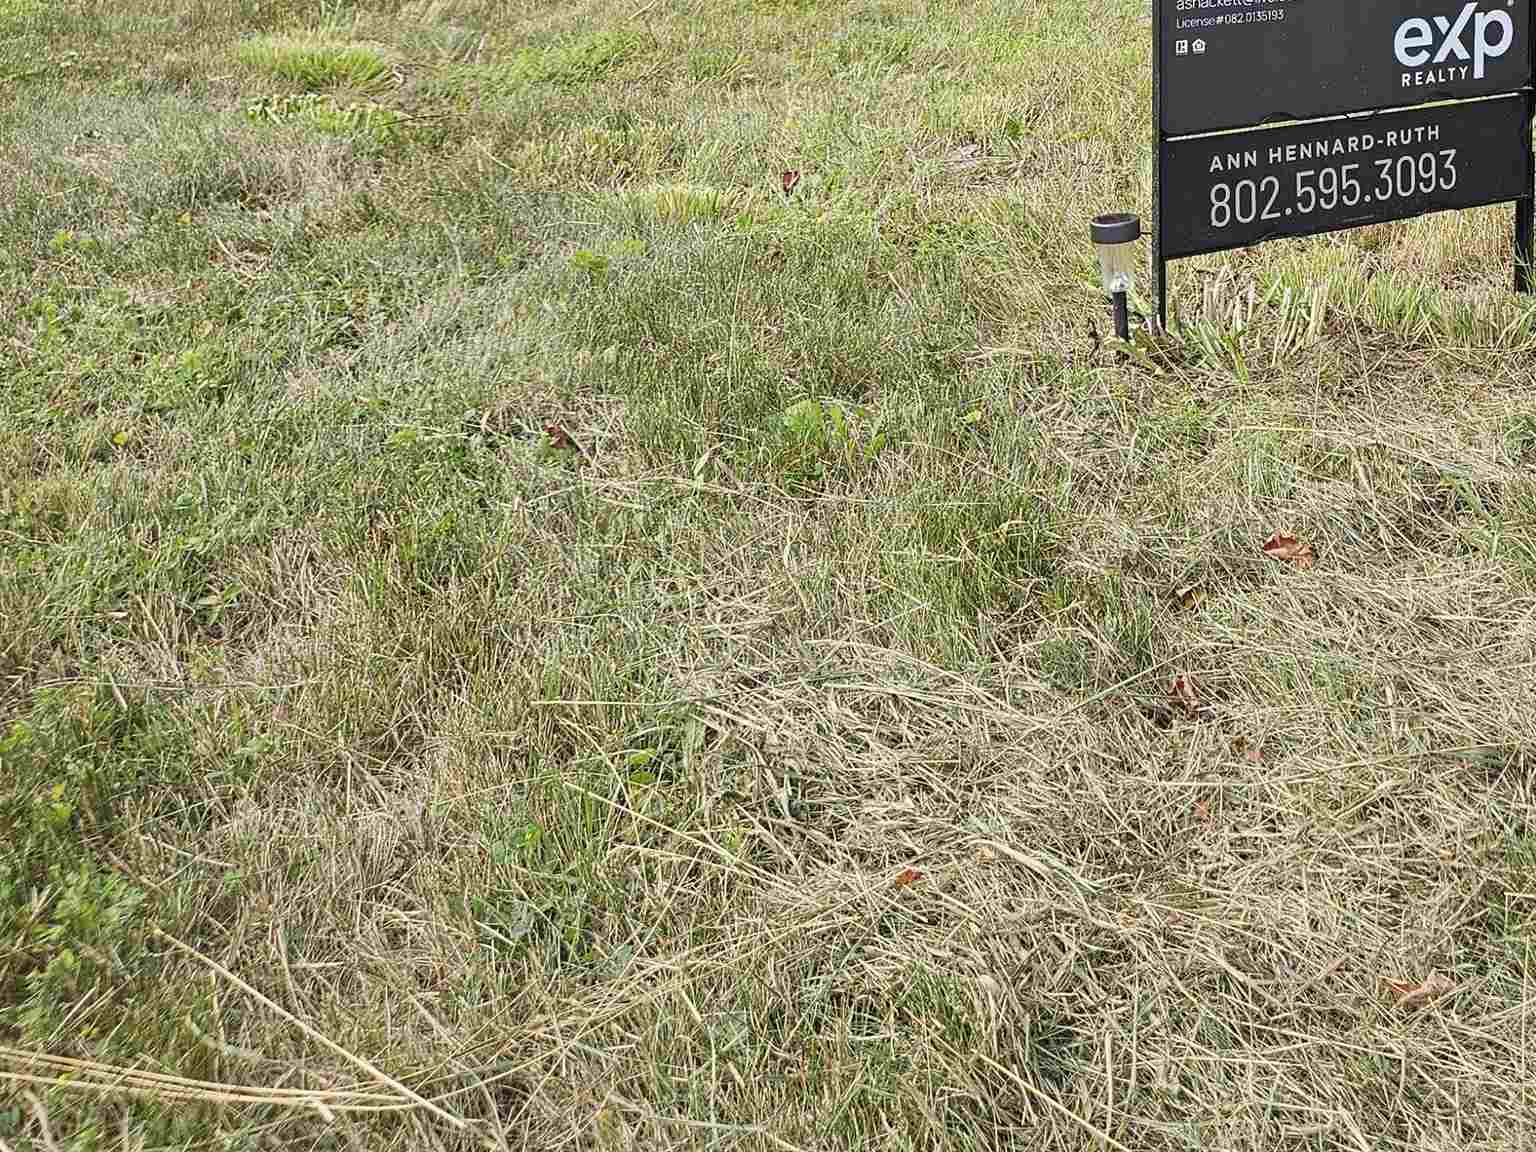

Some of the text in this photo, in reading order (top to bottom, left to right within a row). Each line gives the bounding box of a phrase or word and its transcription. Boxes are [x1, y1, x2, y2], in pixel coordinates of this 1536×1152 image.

[1401, 66, 1468, 87] REALTY
[1209, 124, 1441, 173] ANN HENNARD-RUTH
[1209, 149, 1457, 228] 802.595.3093
